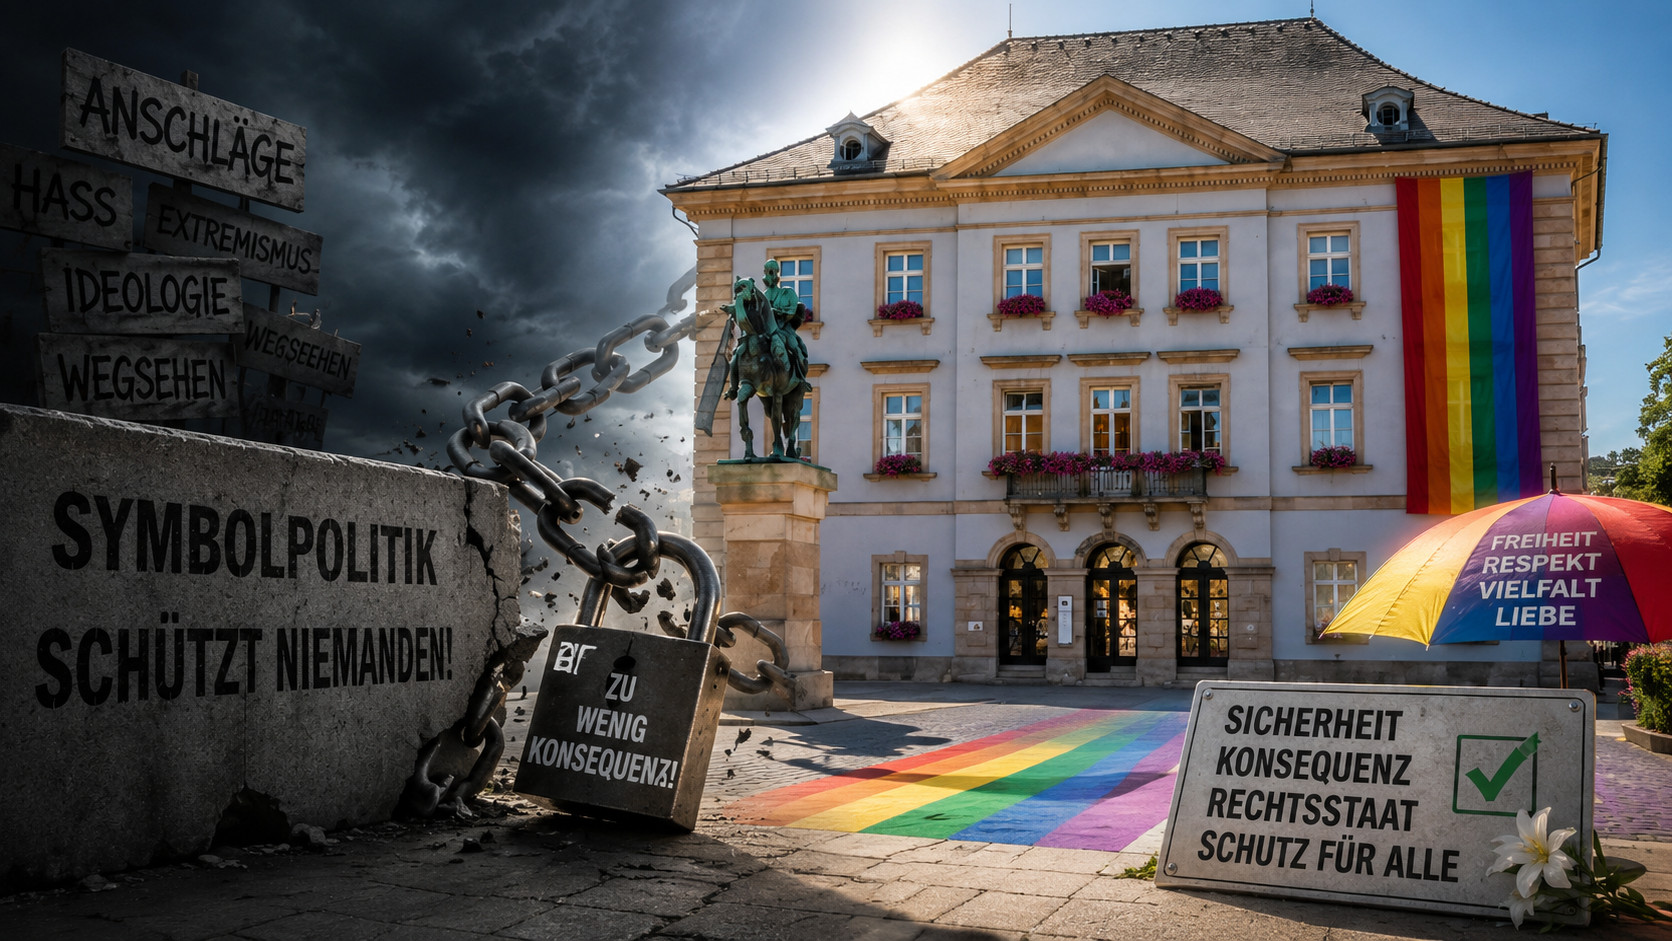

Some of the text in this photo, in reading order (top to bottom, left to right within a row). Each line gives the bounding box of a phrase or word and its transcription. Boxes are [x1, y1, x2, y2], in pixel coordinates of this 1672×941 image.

[80, 76, 296, 186] ANSCHLÄGE
[12, 164, 118, 228] HASS
[157, 204, 313, 276] EXTREMISMUS
[64, 263, 230, 318] IDEOLOGIE
[57, 353, 227, 403] WEGSEHEN
[51, 491, 438, 586] SYMBOLPOLITIK
[1491, 531, 1598, 551] FREIHEIT
[1482, 553, 1602, 575] RESPEKT
[1479, 578, 1602, 600] VIELFALT
[1495, 605, 1576, 627] LIEBE
[35, 612, 453, 709] SCHÜTZT NIEMANDEN!
[605, 672, 637, 703] ZU
[576, 705, 648, 743] WENIG
[1224, 705, 1403, 741] SICHERHEIT
[1215, 746, 1412, 786] KONSEQUENZ
[1206, 787, 1419, 832] RECHTSSTAAT
[1197, 829, 1460, 883] SCHUTZ FÜR ALLE
